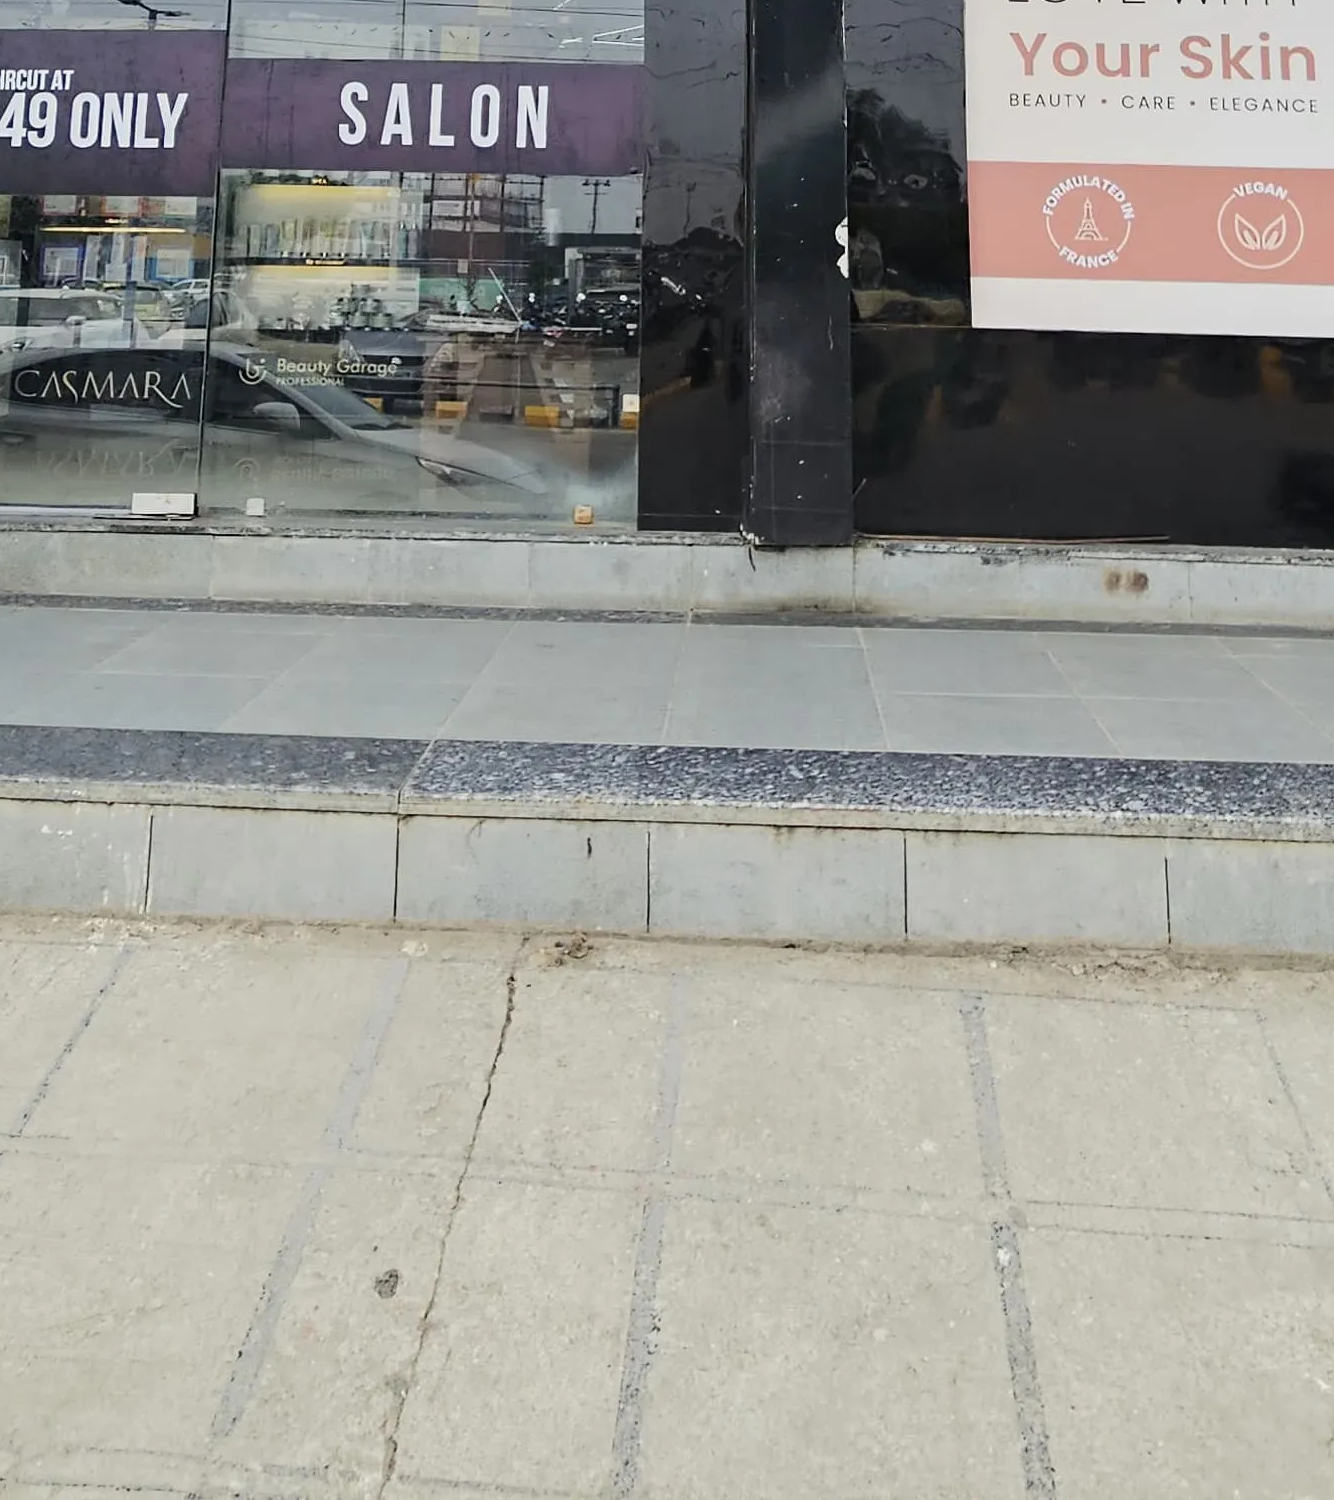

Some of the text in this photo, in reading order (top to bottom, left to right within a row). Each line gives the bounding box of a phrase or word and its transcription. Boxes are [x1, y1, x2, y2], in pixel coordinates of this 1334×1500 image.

[1009, 32, 1317, 82] Your Skin
[51, 69, 75, 91] AT
[338, 81, 549, 149] SALON
[1009, 93, 1319, 114] BEAUTY CARE ELEGANCE
[69, 92, 189, 149] ONLY
[1042, 174, 1135, 220] FORMULATED IN
[1232, 180, 1288, 201] VEGAN
[1058, 245, 1119, 269] FRANCE
[277, 358, 398, 378] Beauty Garage
[14, 370, 192, 409] CASMARA
[275, 377, 346, 388] PROFESSIONAL
